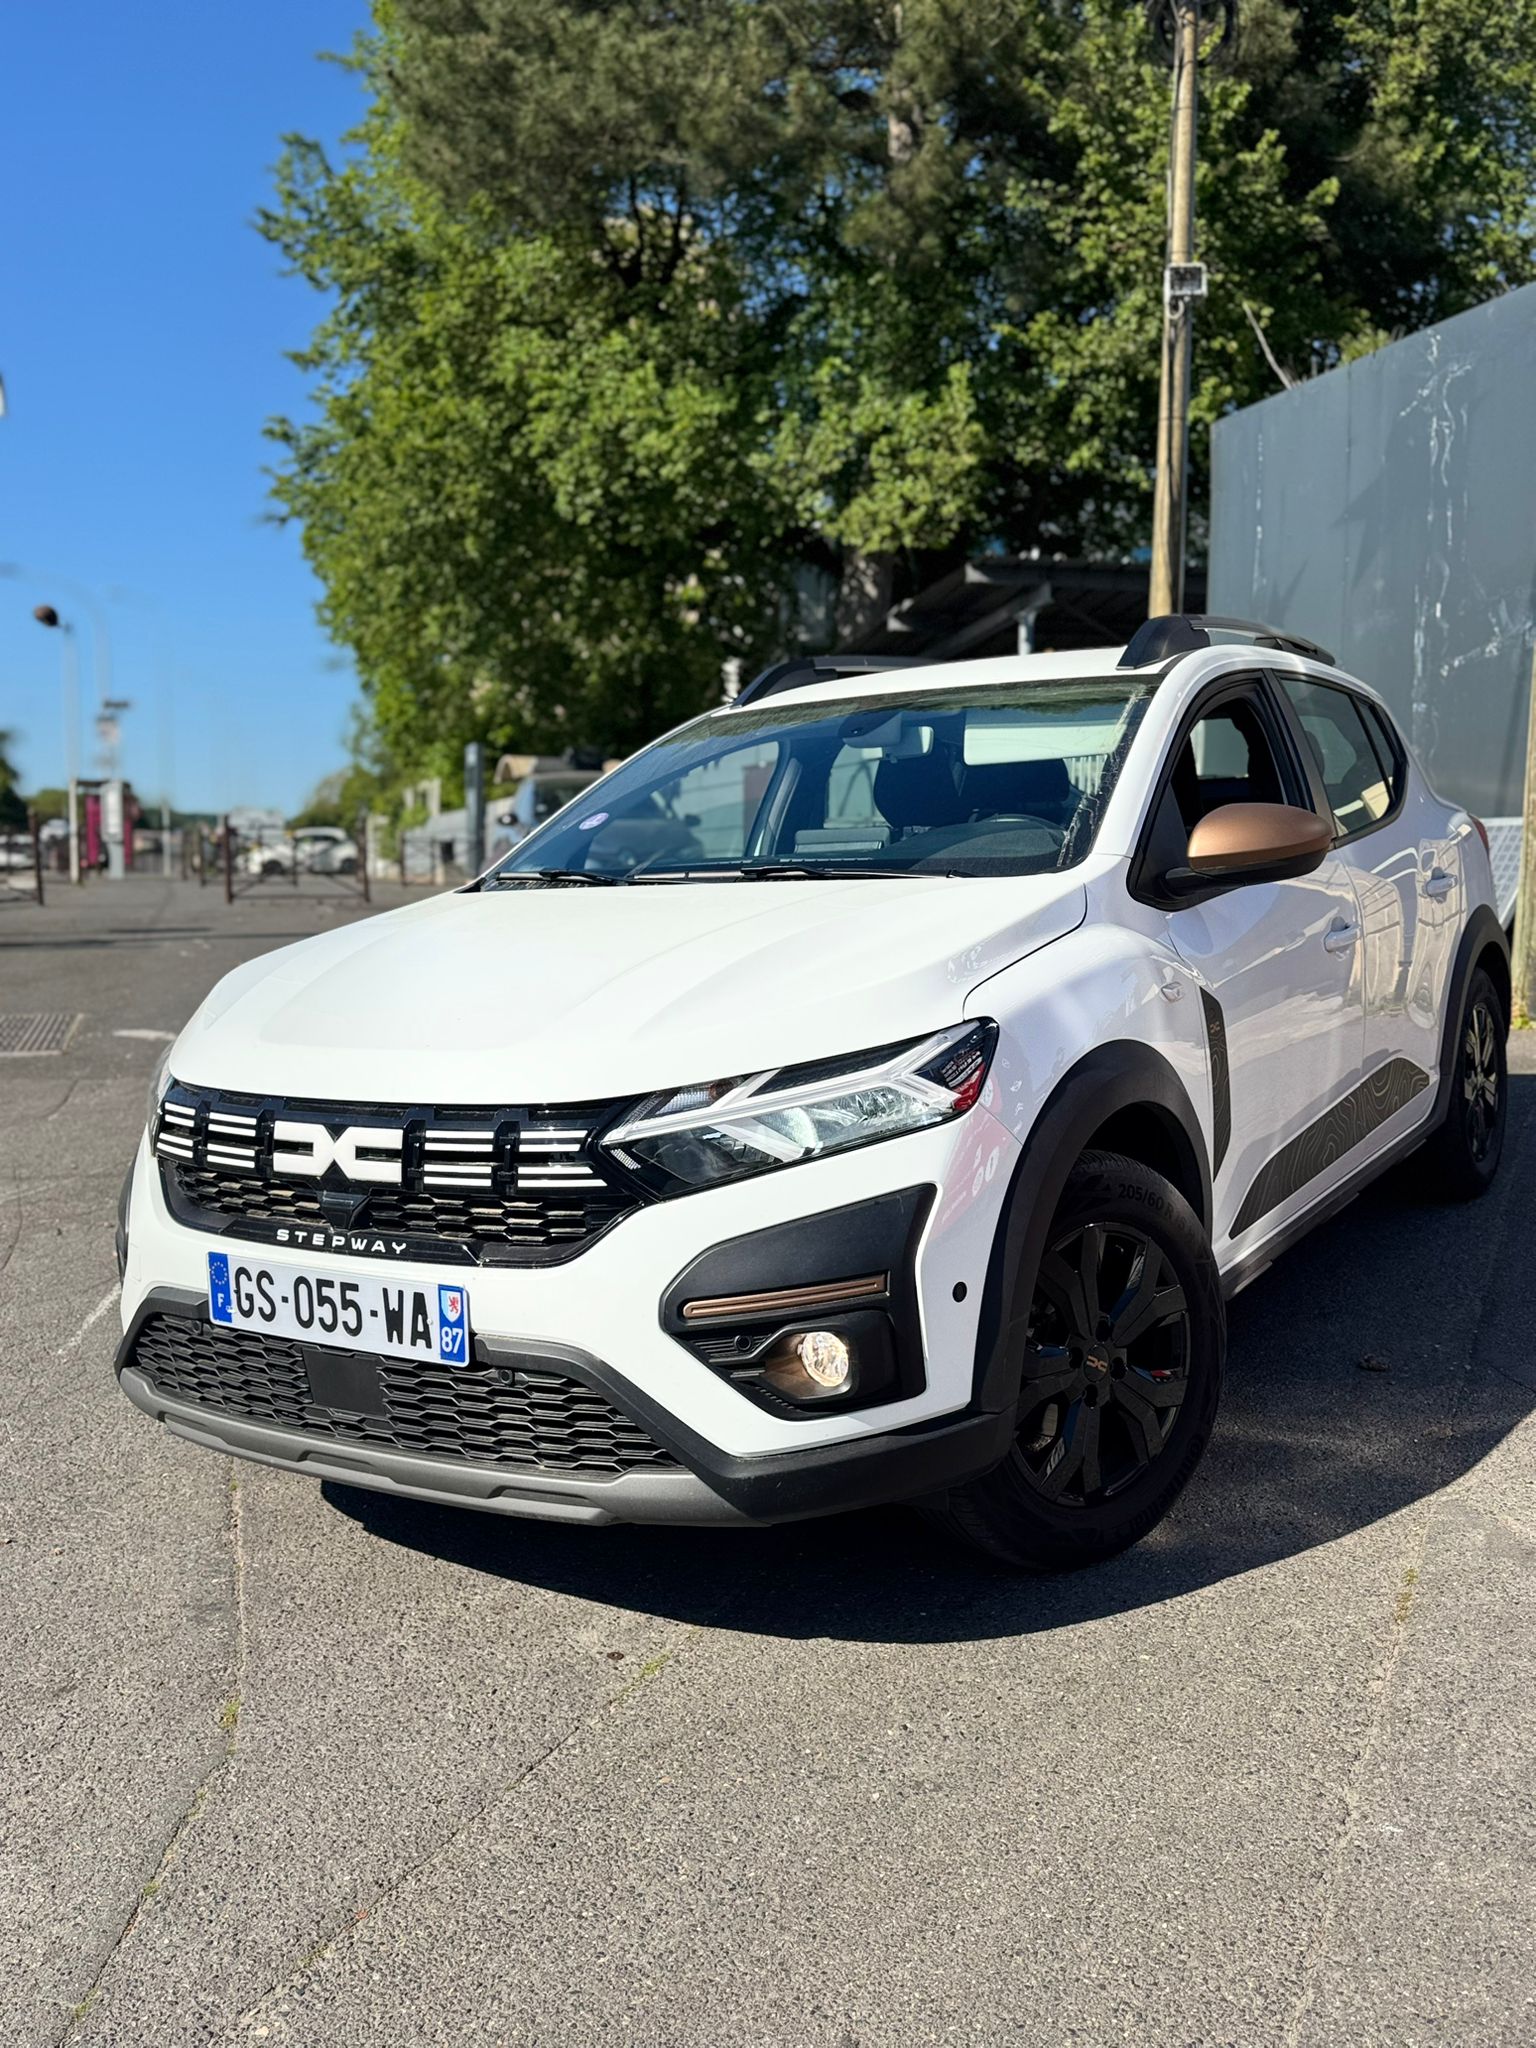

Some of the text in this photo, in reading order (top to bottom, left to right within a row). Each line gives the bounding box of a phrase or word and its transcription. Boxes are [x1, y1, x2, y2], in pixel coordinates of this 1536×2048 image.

[1118, 1183, 1165, 1210] 205/60
[276, 1229, 407, 1254] STEPWAY
[217, 1293, 225, 1308] F
[234, 1266, 432, 1349] GS-055-WA
[441, 1326, 464, 1354] 87
